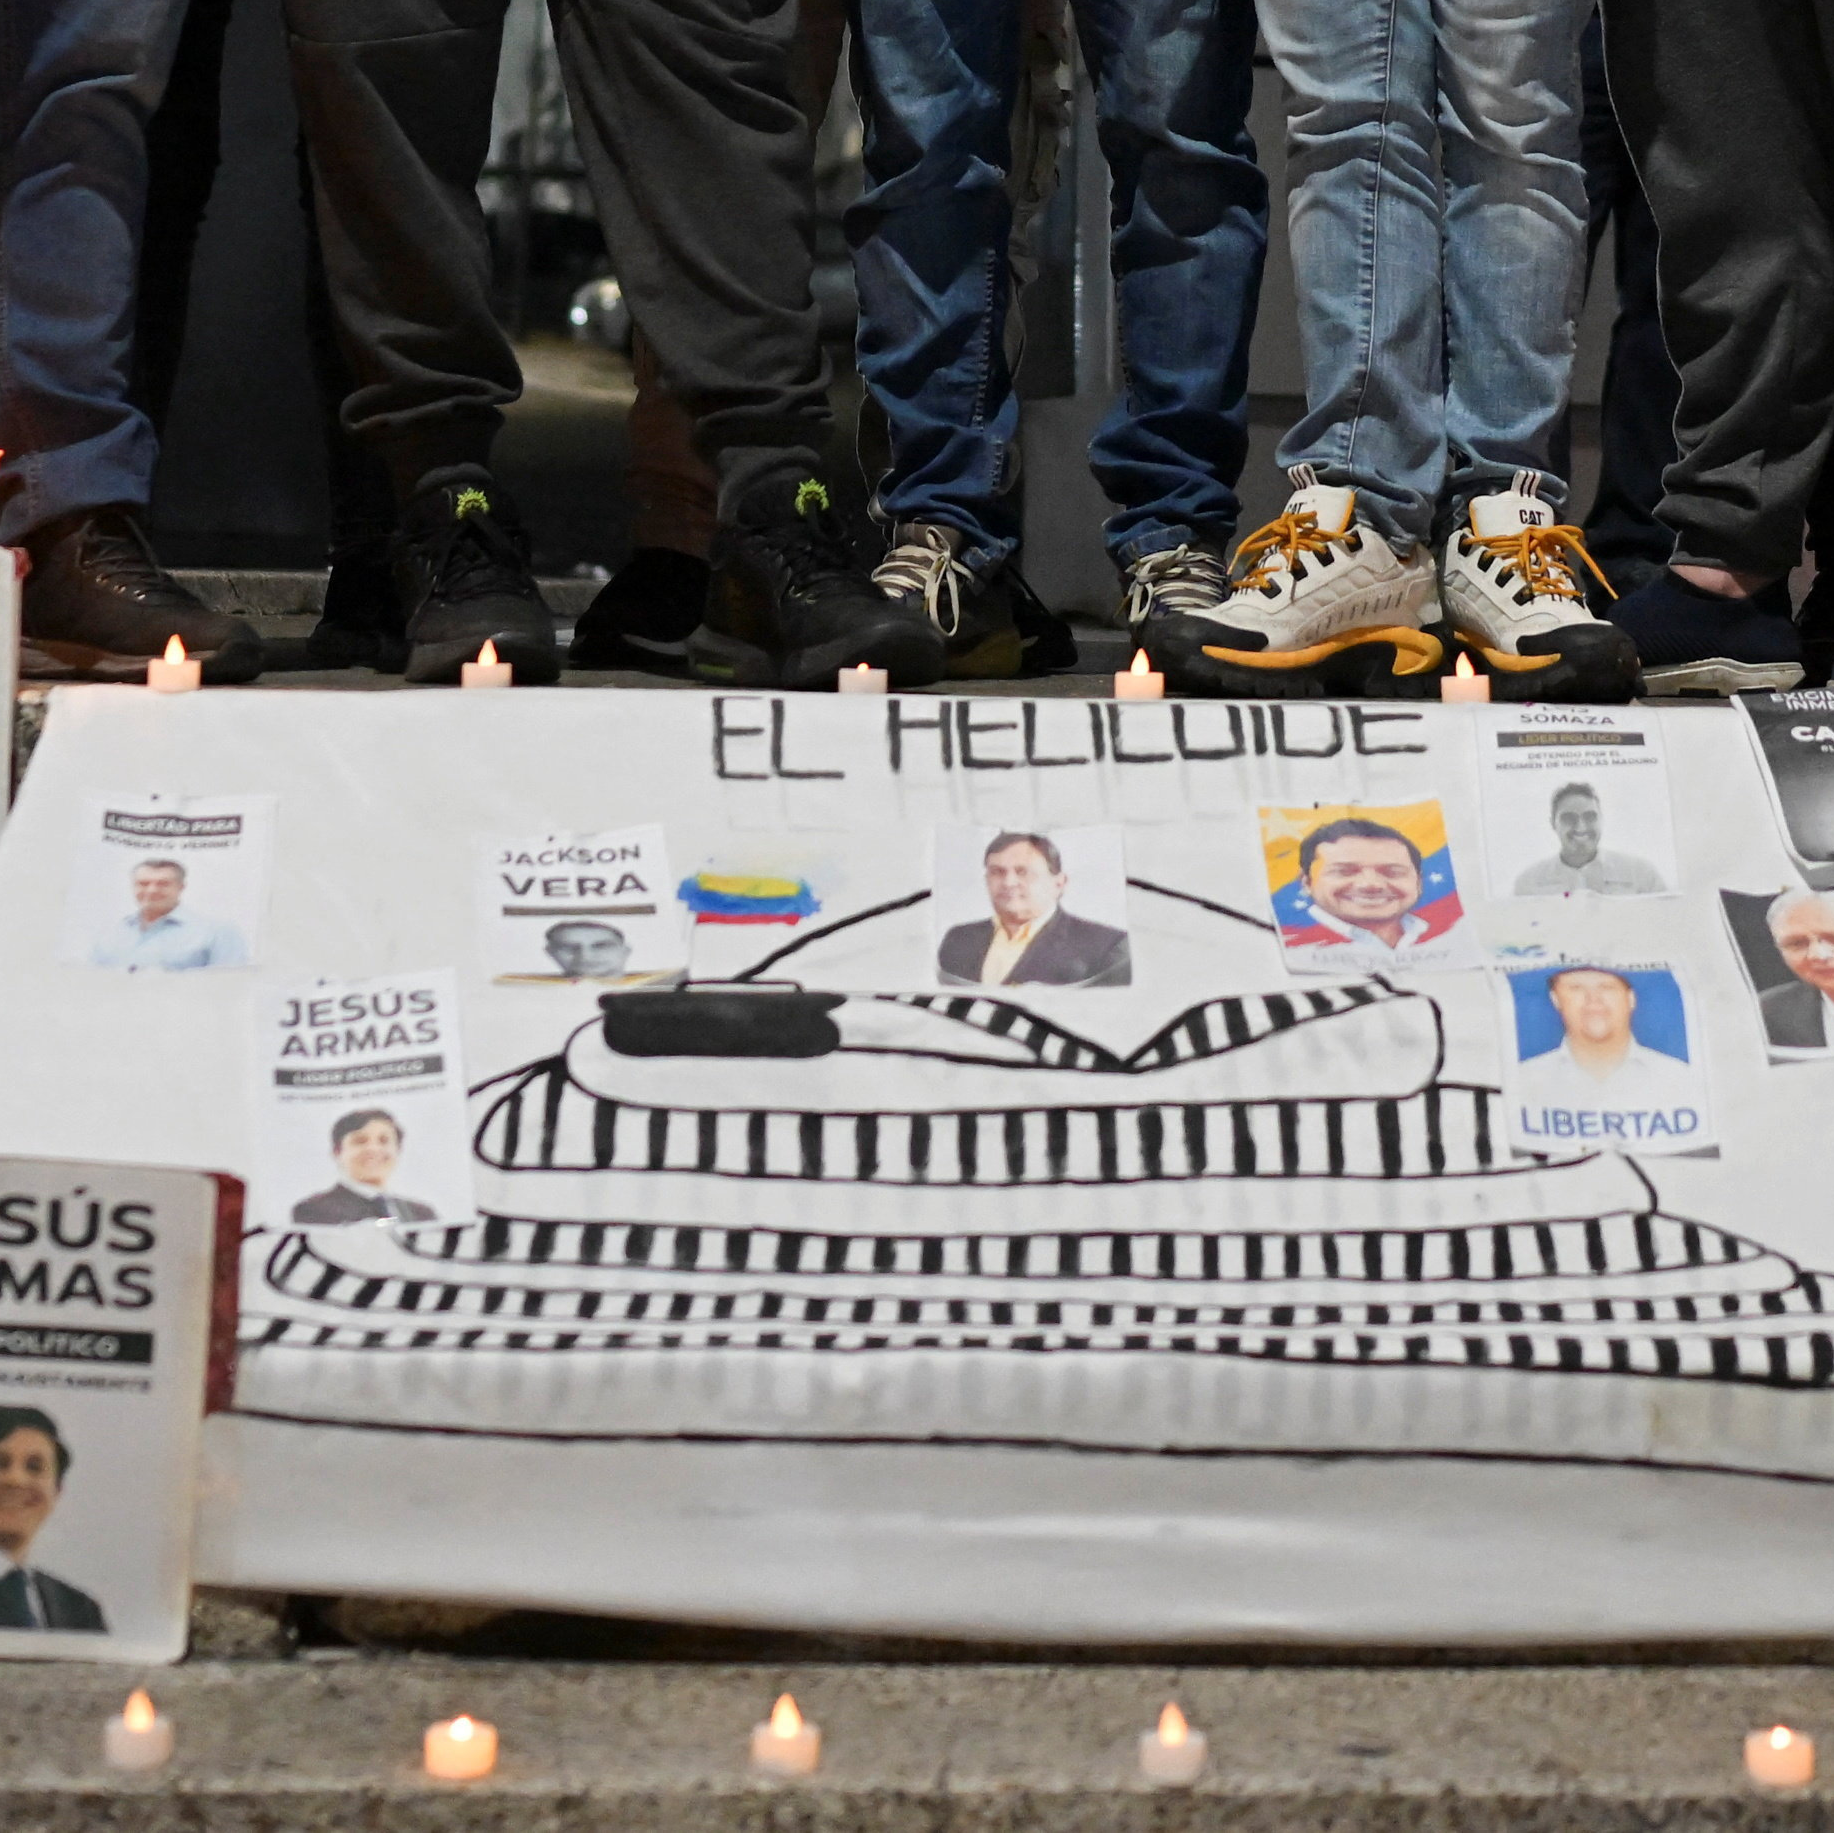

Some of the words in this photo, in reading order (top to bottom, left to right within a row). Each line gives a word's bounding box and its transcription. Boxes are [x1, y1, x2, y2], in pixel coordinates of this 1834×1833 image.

[1520, 714, 1615, 725] SOMAZA
[713, 696, 844, 779] EL
[1612, 757, 1658, 765] MADURO
[502, 844, 640, 865] JACKSON
[502, 873, 648, 896] VERA
[280, 988, 436, 1028] JESÚS
[281, 1019, 439, 1057] ARMAS
[1520, 1106, 1699, 1138] LIBERTAD
